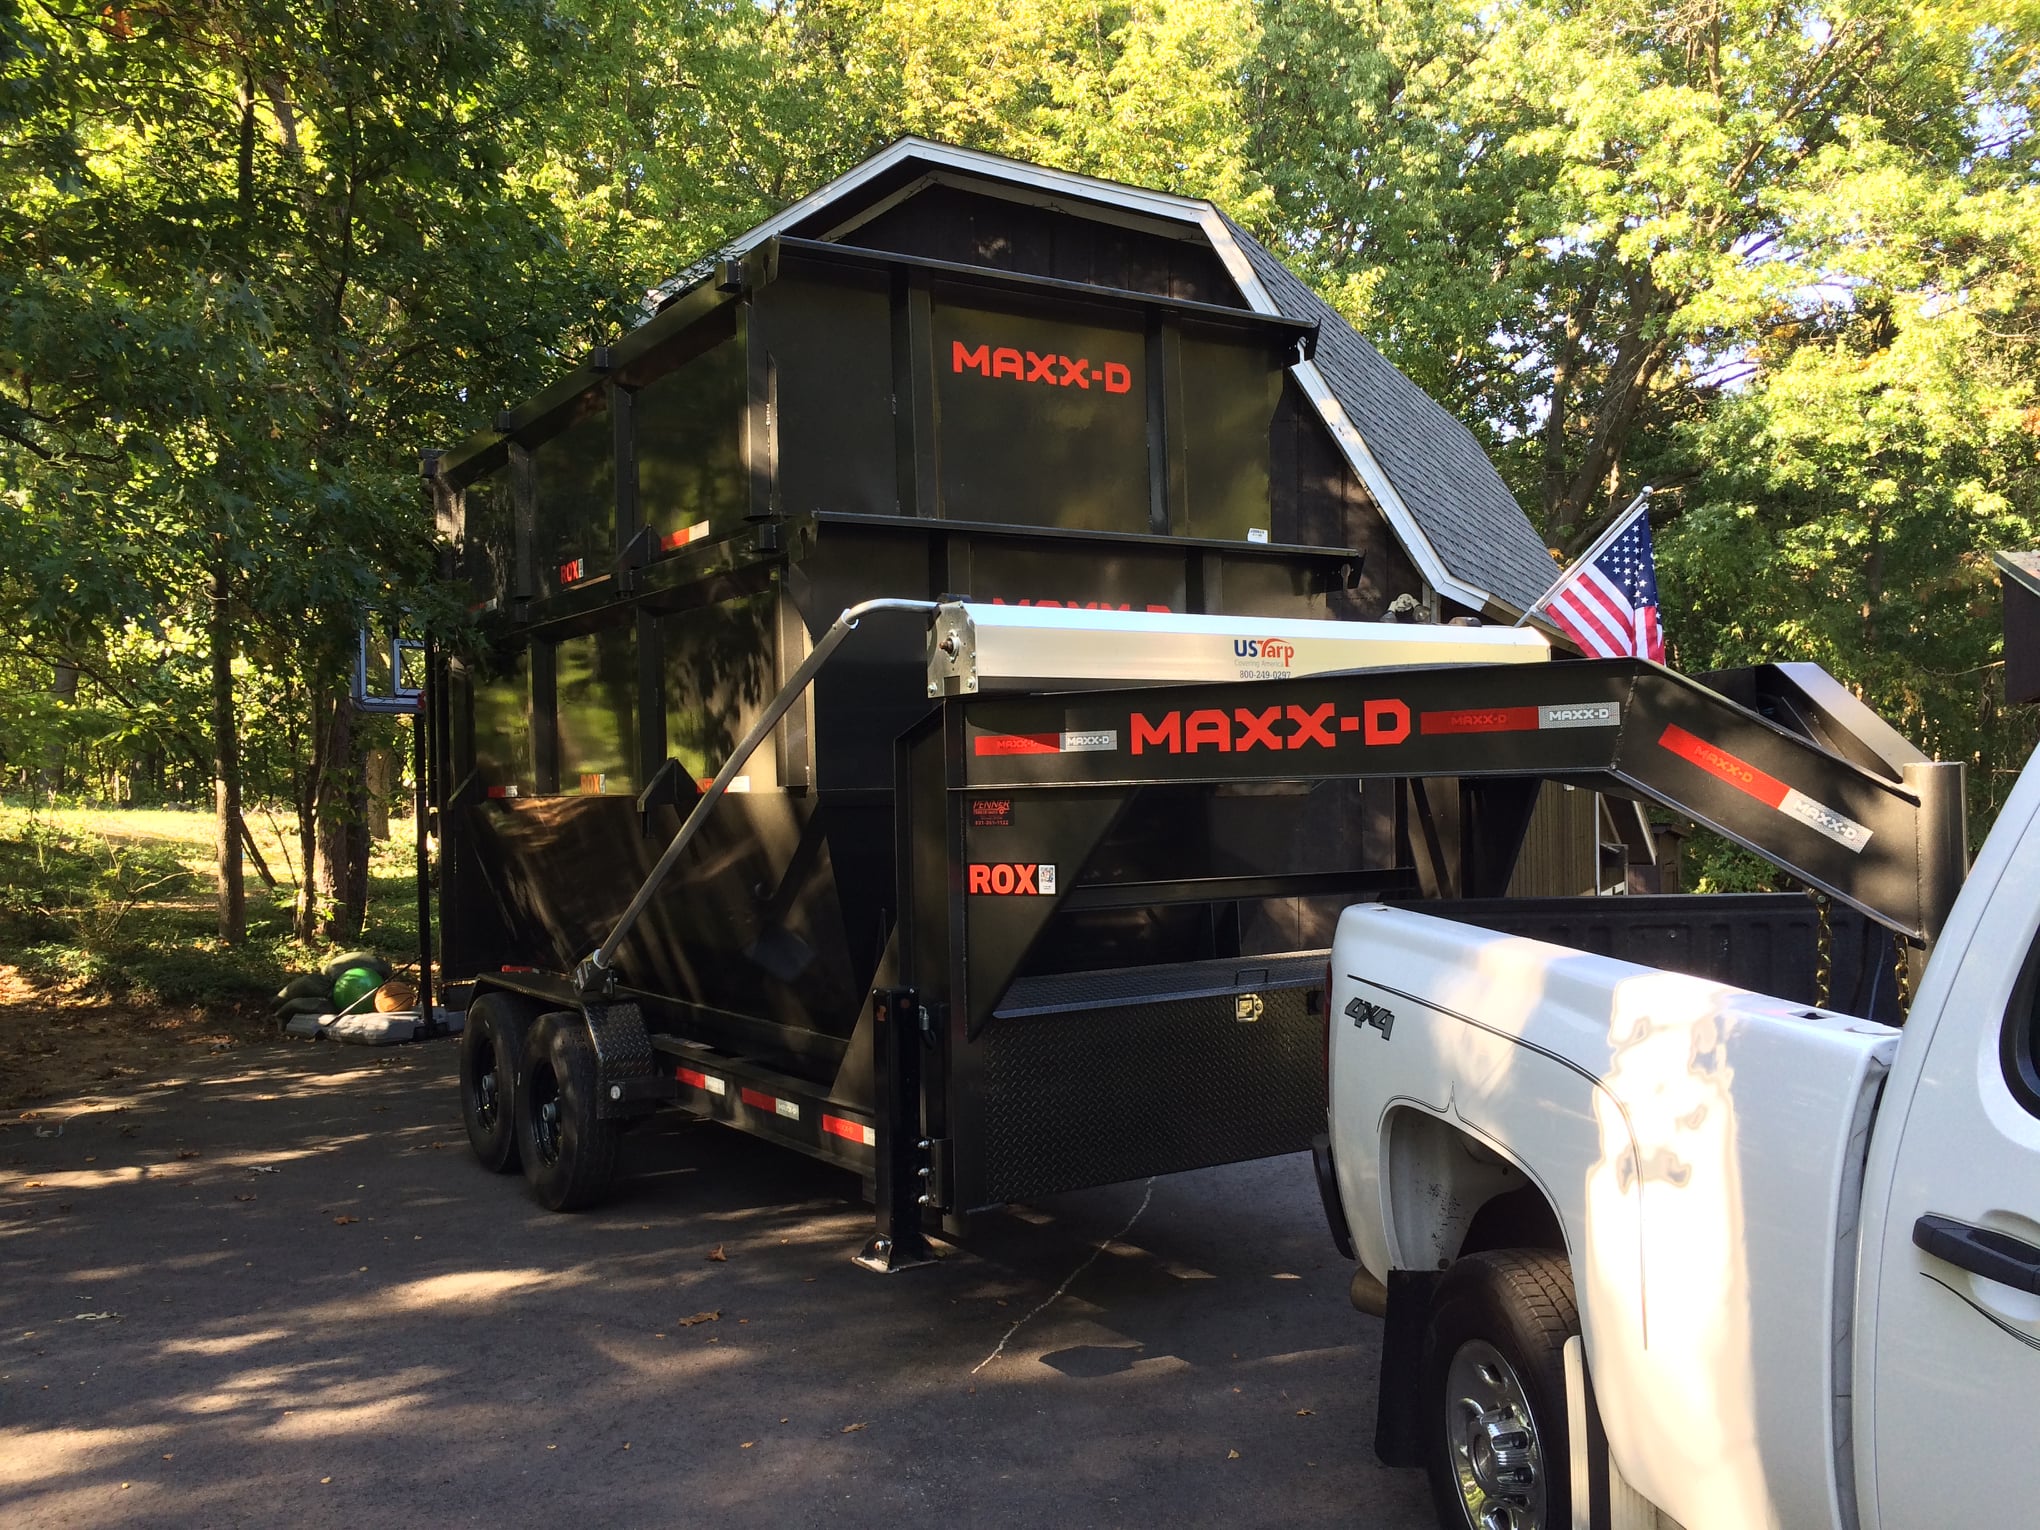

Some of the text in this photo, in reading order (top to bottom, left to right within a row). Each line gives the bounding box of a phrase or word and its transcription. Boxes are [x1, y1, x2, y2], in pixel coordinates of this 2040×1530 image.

[952, 341, 1131, 394] MAXX-D
[1130, 699, 1411, 755] MAXX-D
[1451, 714, 1508, 726] MAXX-D
[1548, 708, 1610, 721] MAXX-D
[1066, 735, 1110, 747] MAXX-D
[1693, 745, 1754, 783] MAXX-D
[1793, 800, 1858, 840] MAXX-D
[969, 863, 1038, 895] ROX
